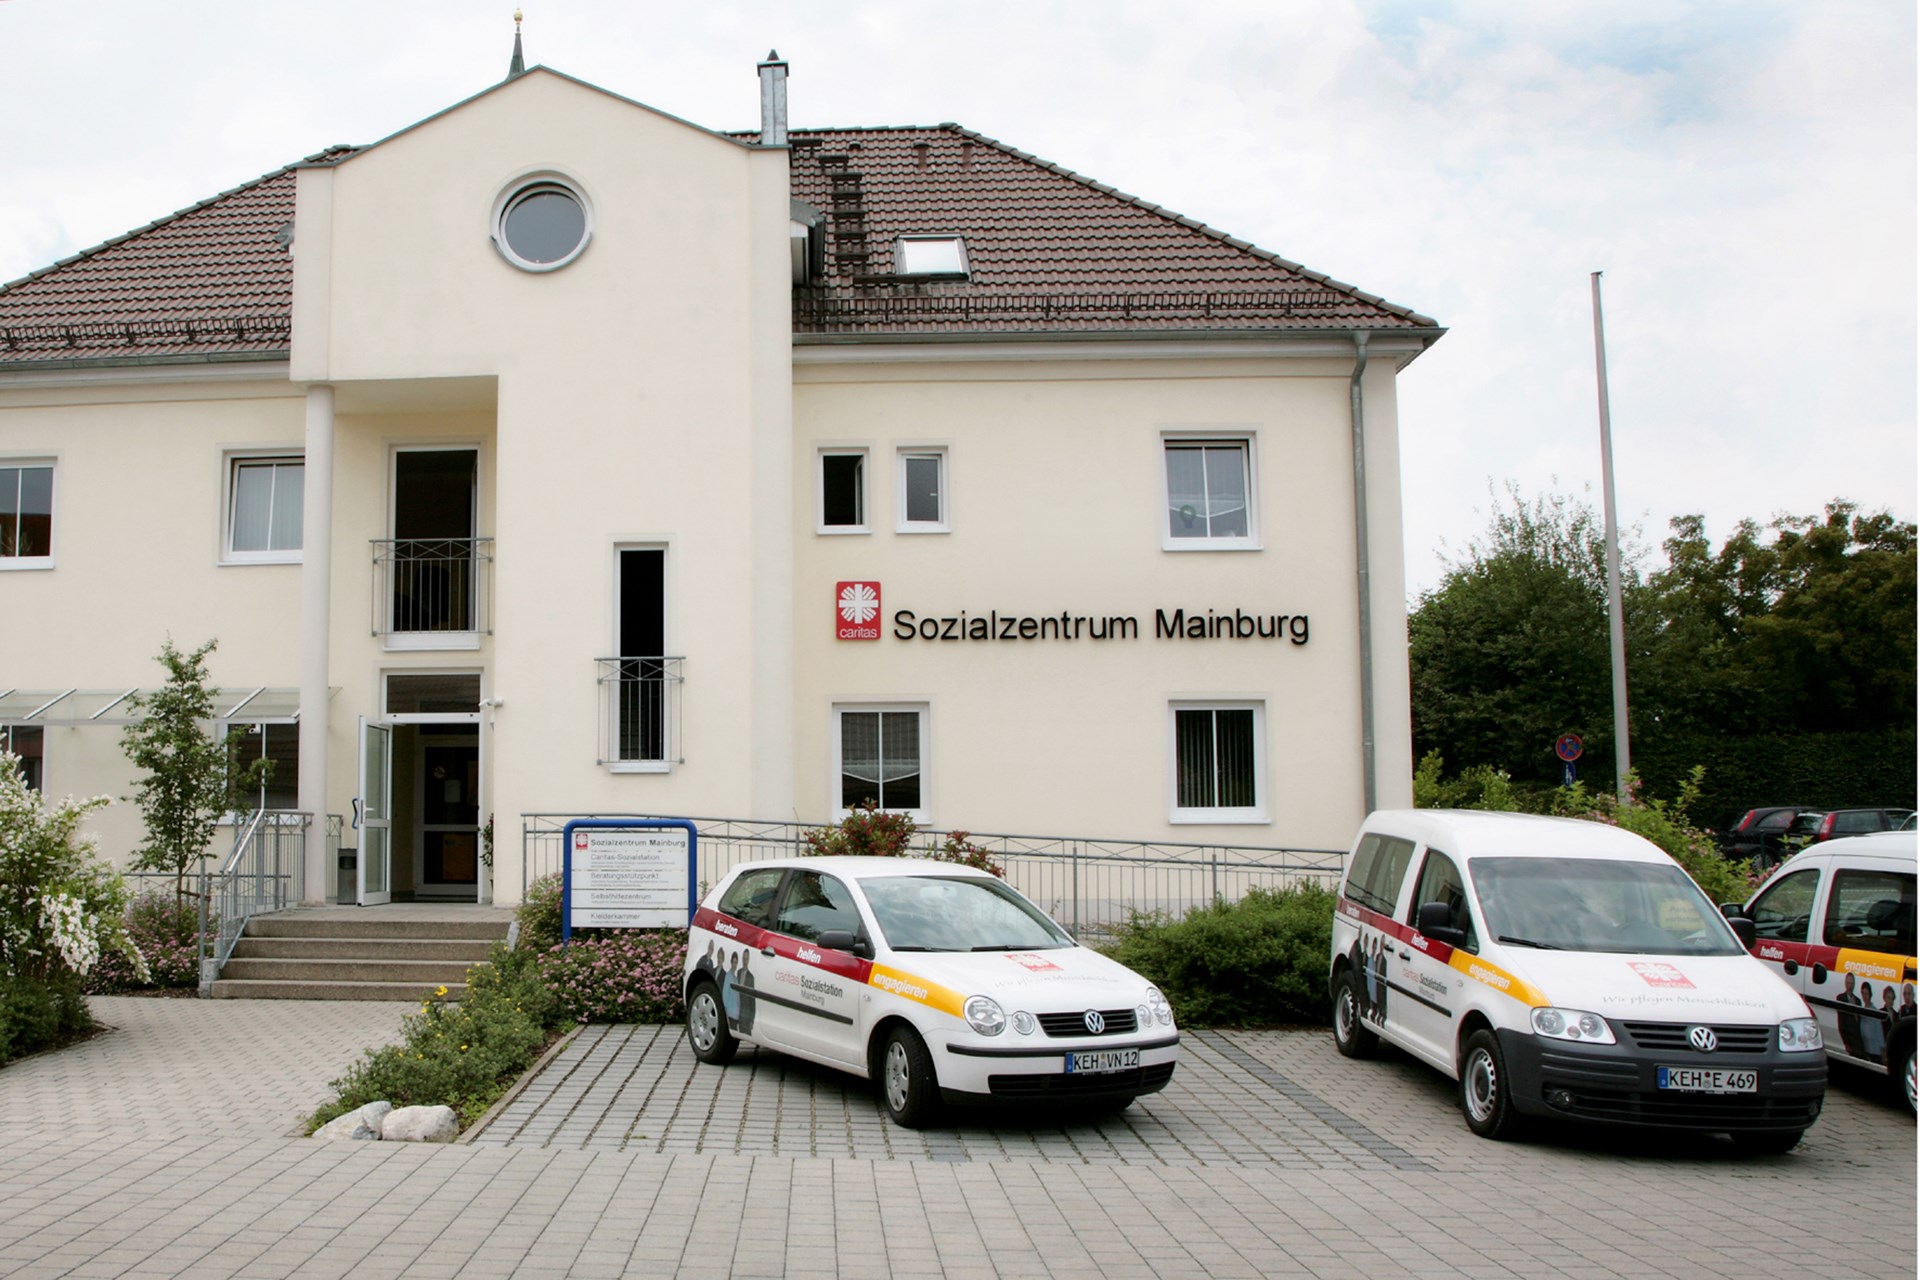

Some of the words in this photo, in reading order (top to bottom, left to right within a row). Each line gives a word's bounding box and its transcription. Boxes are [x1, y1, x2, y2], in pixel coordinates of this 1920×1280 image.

[840, 626, 877, 638] caritas
[893, 609, 1139, 641] Sozialzentrum
[1154, 608, 1310, 646] Mainburg
[591, 839, 647, 847] Sozialzentrum
[649, 839, 686, 848] Mainburg
[715, 919, 738, 938] beraten
[1411, 932, 1429, 951] helfen
[796, 946, 821, 965] helfen
[1760, 946, 1783, 960] helfen
[1469, 963, 1510, 990] engagieren
[1844, 960, 1897, 979] engagieren
[800, 975, 843, 998] Sozialstation
[873, 972, 928, 1000] engagieren
[1074, 1054, 1099, 1070] KEH
[1107, 1053, 1122, 1068] VN
[1124, 1051, 1138, 1066] 12
[1669, 1071, 1701, 1087] KEH
[1713, 1072, 1723, 1088] E
[1726, 1073, 1755, 1089] 469
